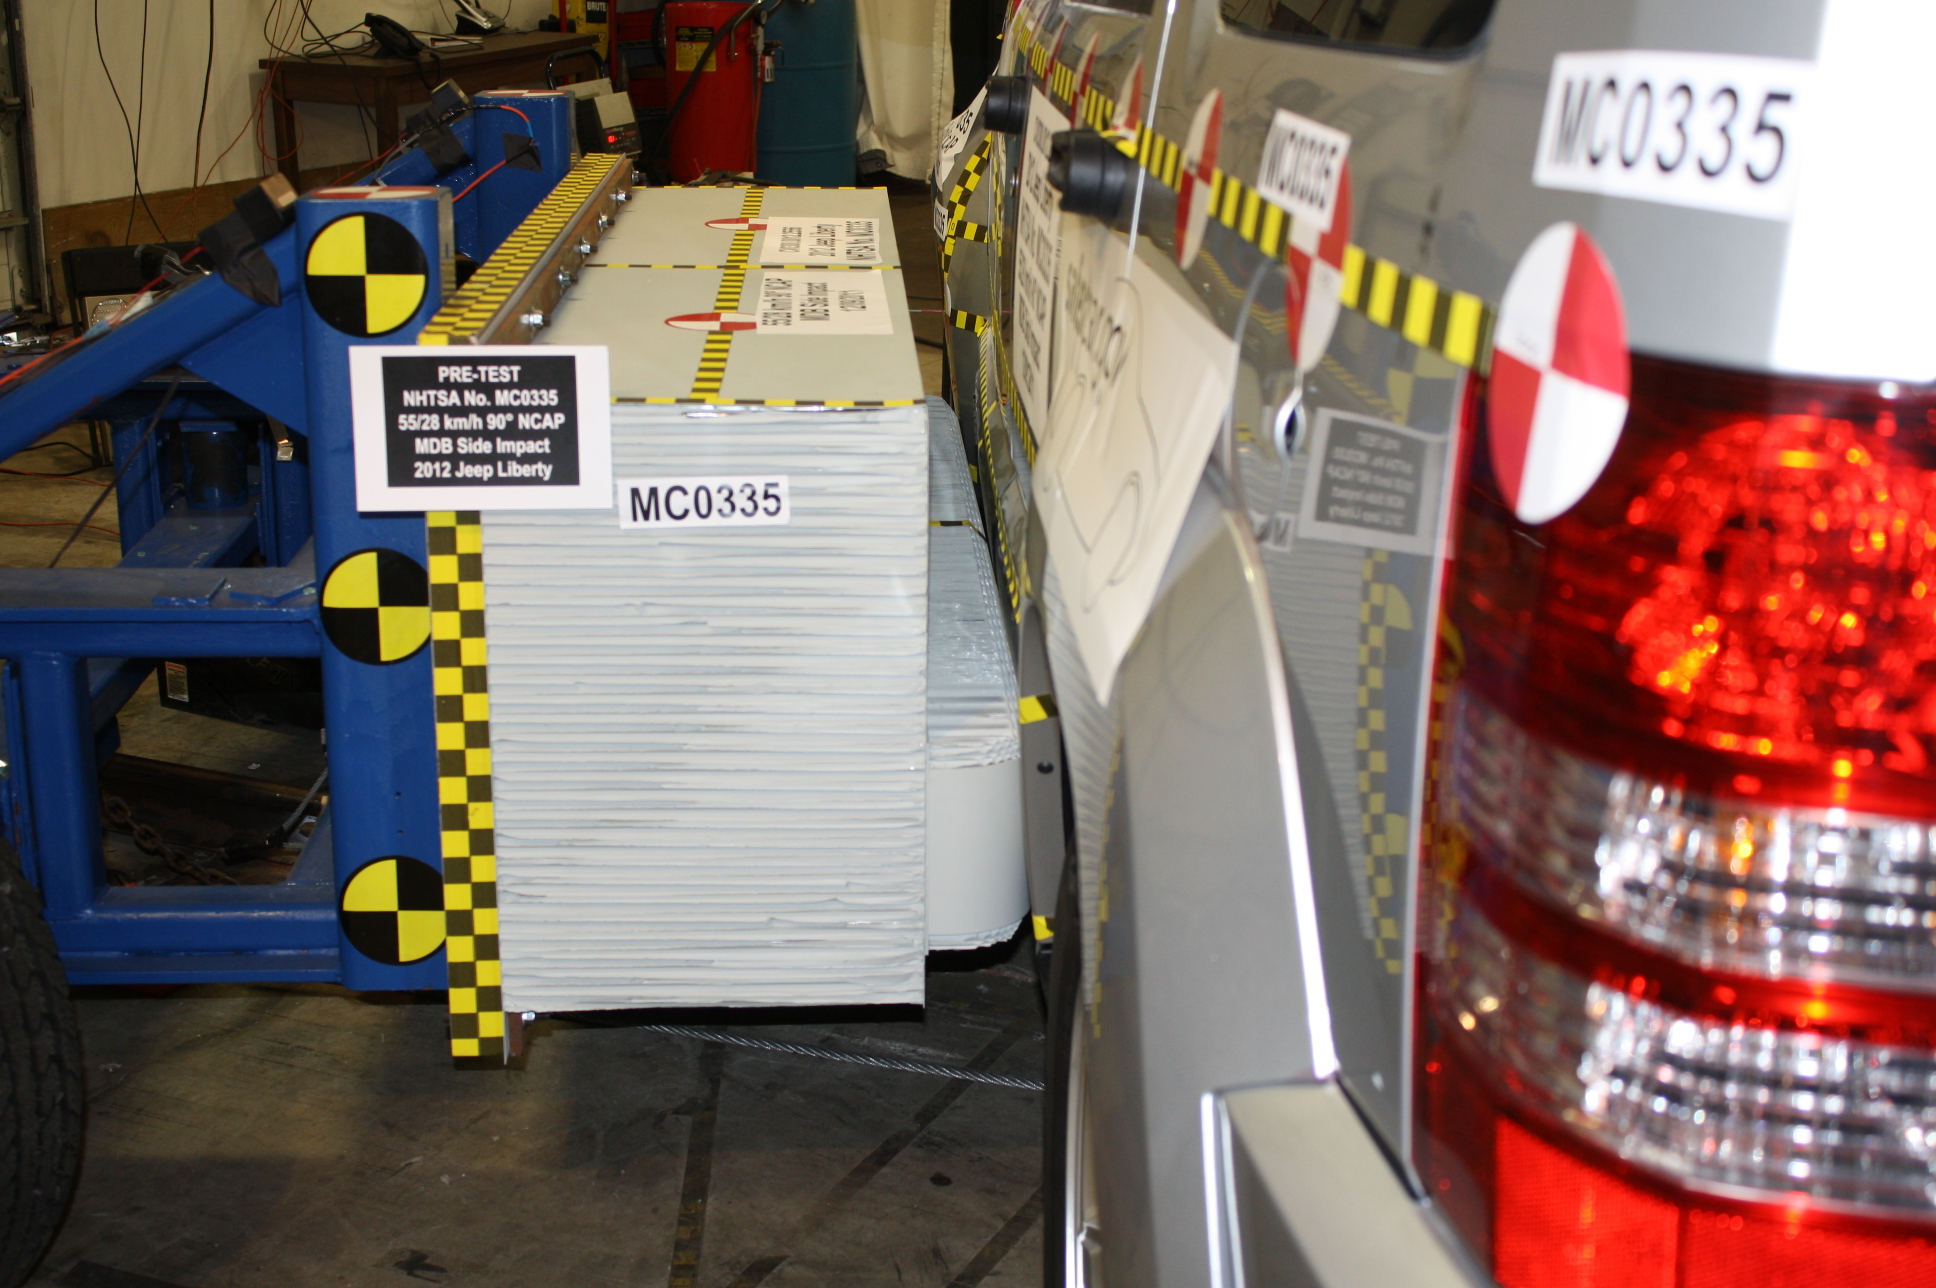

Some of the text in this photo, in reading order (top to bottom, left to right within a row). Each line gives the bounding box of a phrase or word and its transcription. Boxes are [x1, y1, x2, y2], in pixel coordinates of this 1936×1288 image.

[586, 1, 607, 11] BRUTE
[1550, 78, 1792, 184] MC0335
[438, 365, 521, 383] PRE-TEST
[402, 389, 559, 407] NHTSA No. MC0335
[398, 413, 566, 431] 55/28 km/h 90° NCAP
[414, 437, 552, 457] MDB Side Impact
[413, 461, 553, 481] 2012 Jeep Liberty
[630, 482, 782, 522] MC0335
